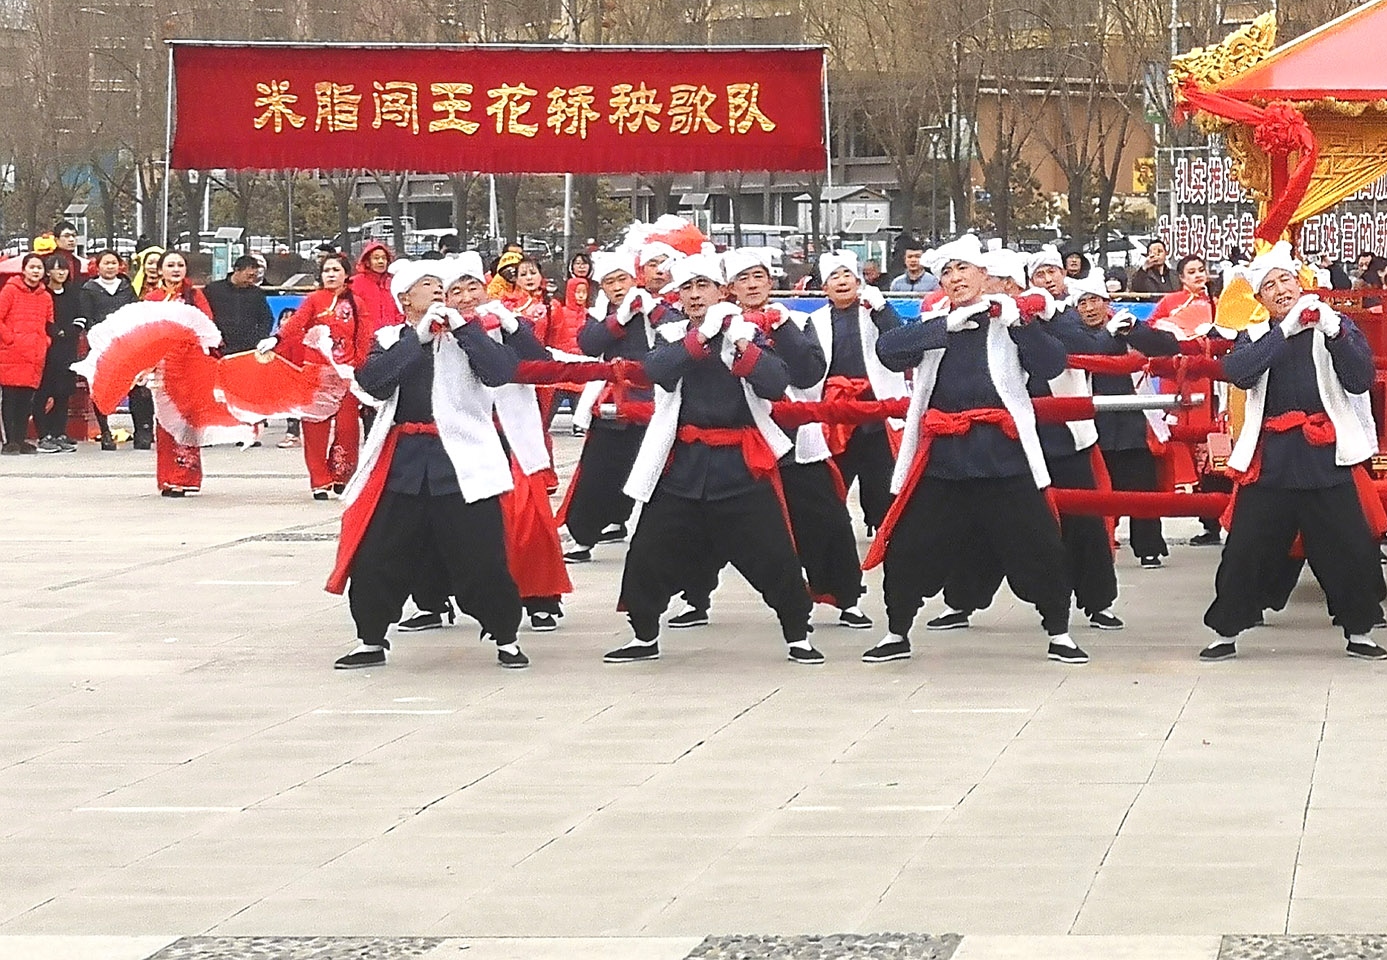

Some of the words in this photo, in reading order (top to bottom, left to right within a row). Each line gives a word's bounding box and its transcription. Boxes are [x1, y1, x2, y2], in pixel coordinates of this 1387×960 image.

[253, 78, 776, 139] 米脂闯王花轿秧歌队
